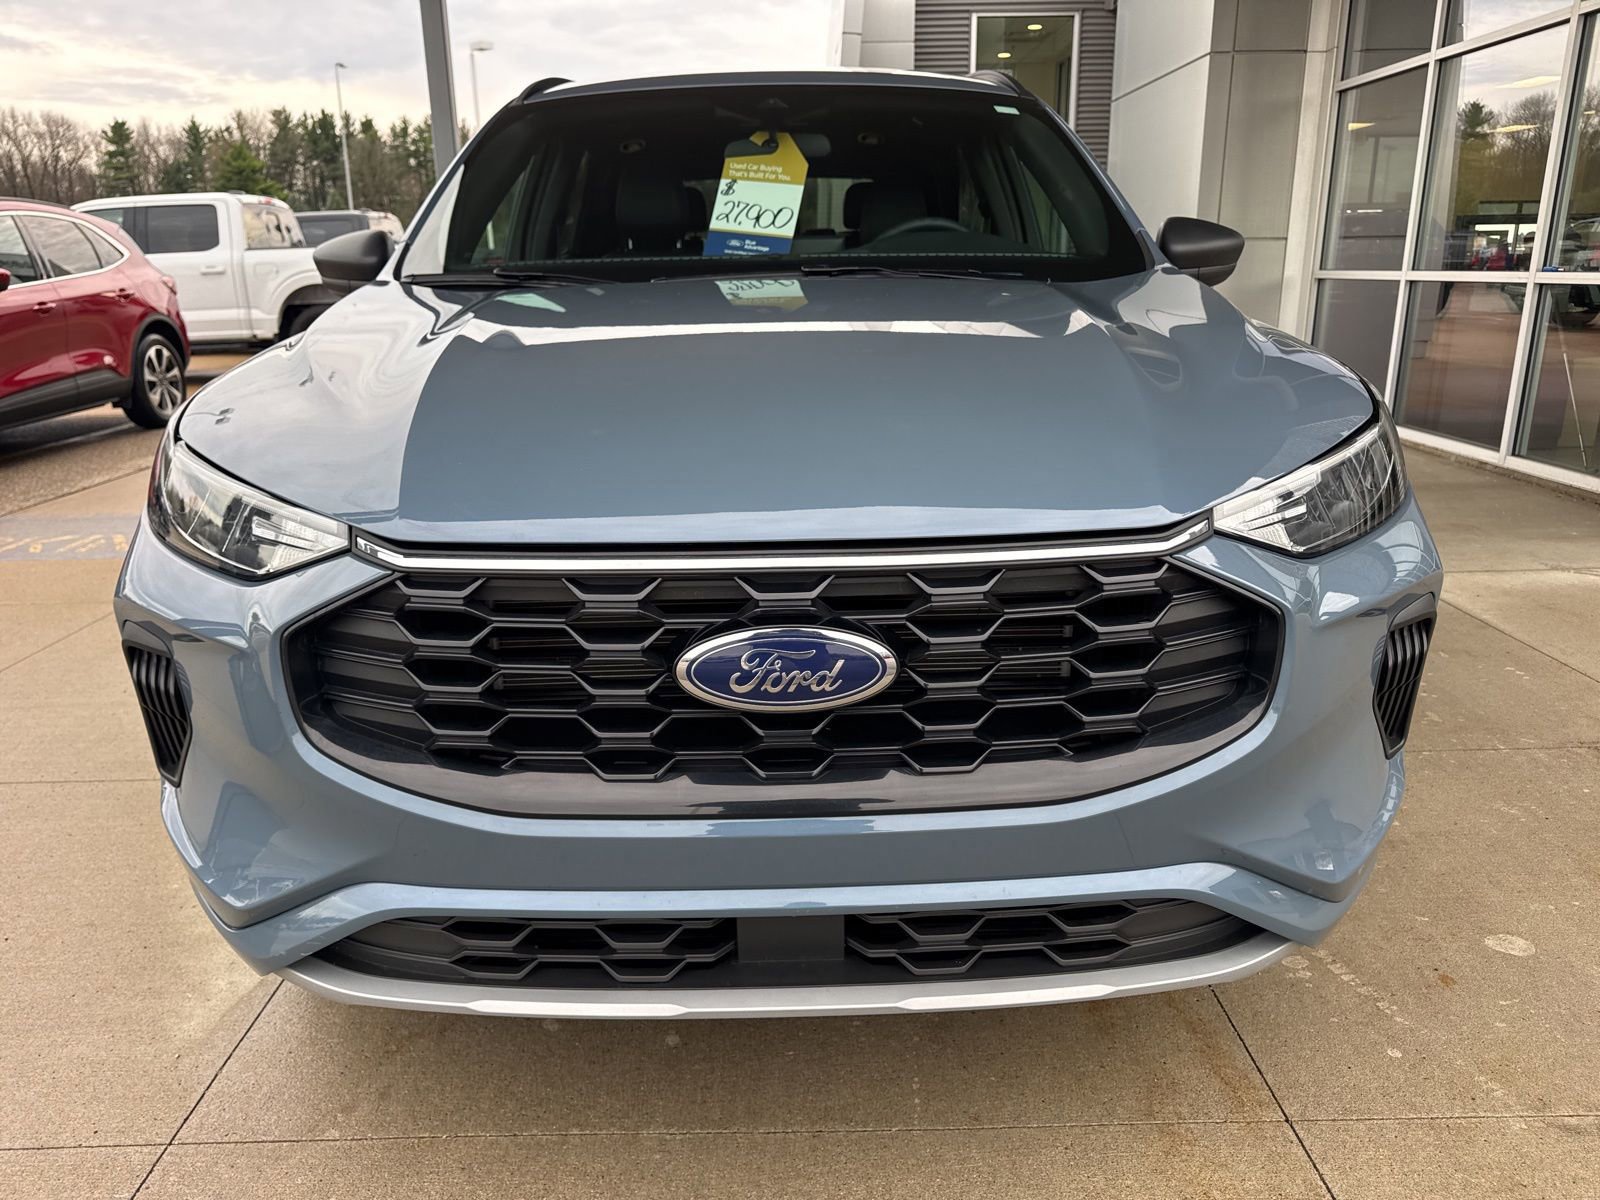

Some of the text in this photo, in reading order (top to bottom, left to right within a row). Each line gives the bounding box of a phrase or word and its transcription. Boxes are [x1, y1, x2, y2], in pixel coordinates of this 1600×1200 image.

[729, 169, 748, 178] That's
[748, 171, 765, 179] Built
[765, 172, 777, 180] For
[730, 162, 783, 174] Used Car Buying
[720, 179, 738, 196] $
[715, 200, 794, 229] 27,900
[728, 648, 846, 694] Ford
